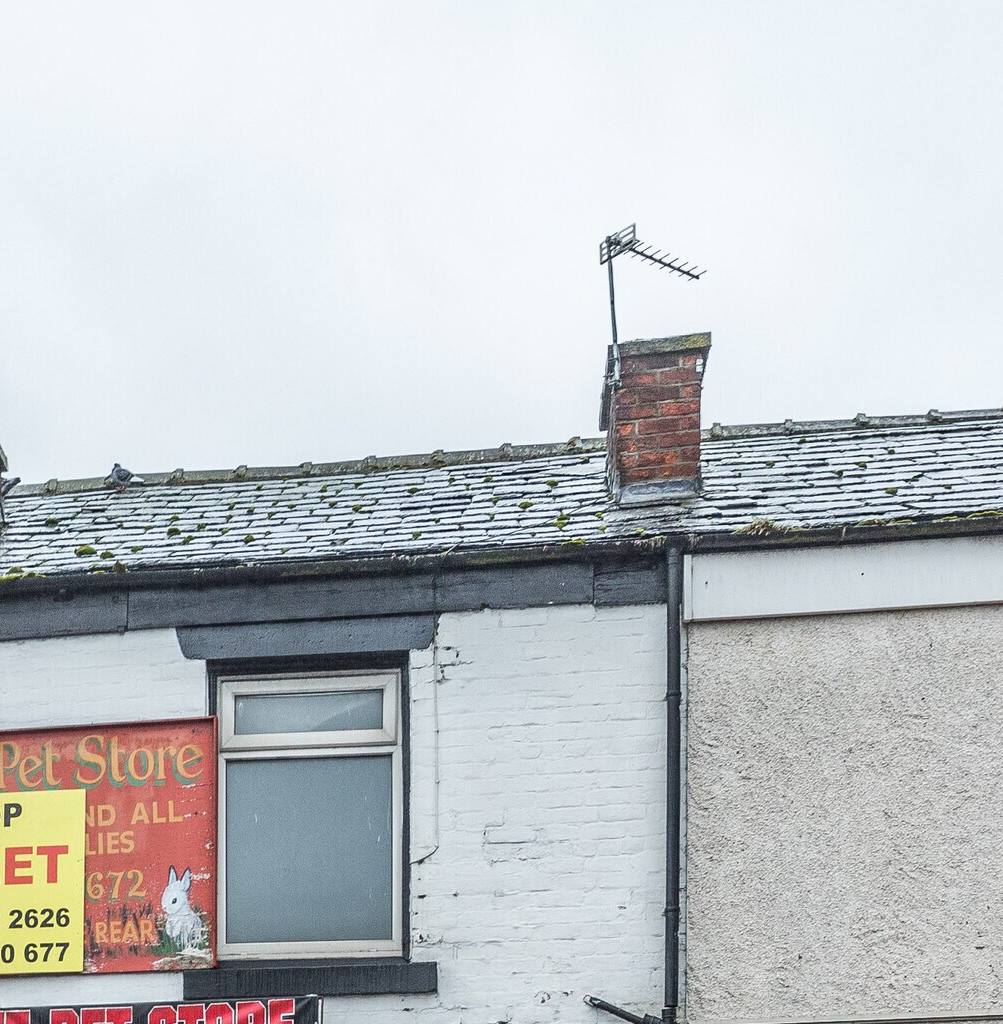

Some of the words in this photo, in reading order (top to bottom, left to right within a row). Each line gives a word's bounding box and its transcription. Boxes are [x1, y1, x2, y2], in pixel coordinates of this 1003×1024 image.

[73, 734, 205, 789] Store
[130, 800, 183, 825] ALL
[9, 908, 70, 929] 2626
[95, 919, 158, 944] REAR
[24, 942, 70, 963] 677
